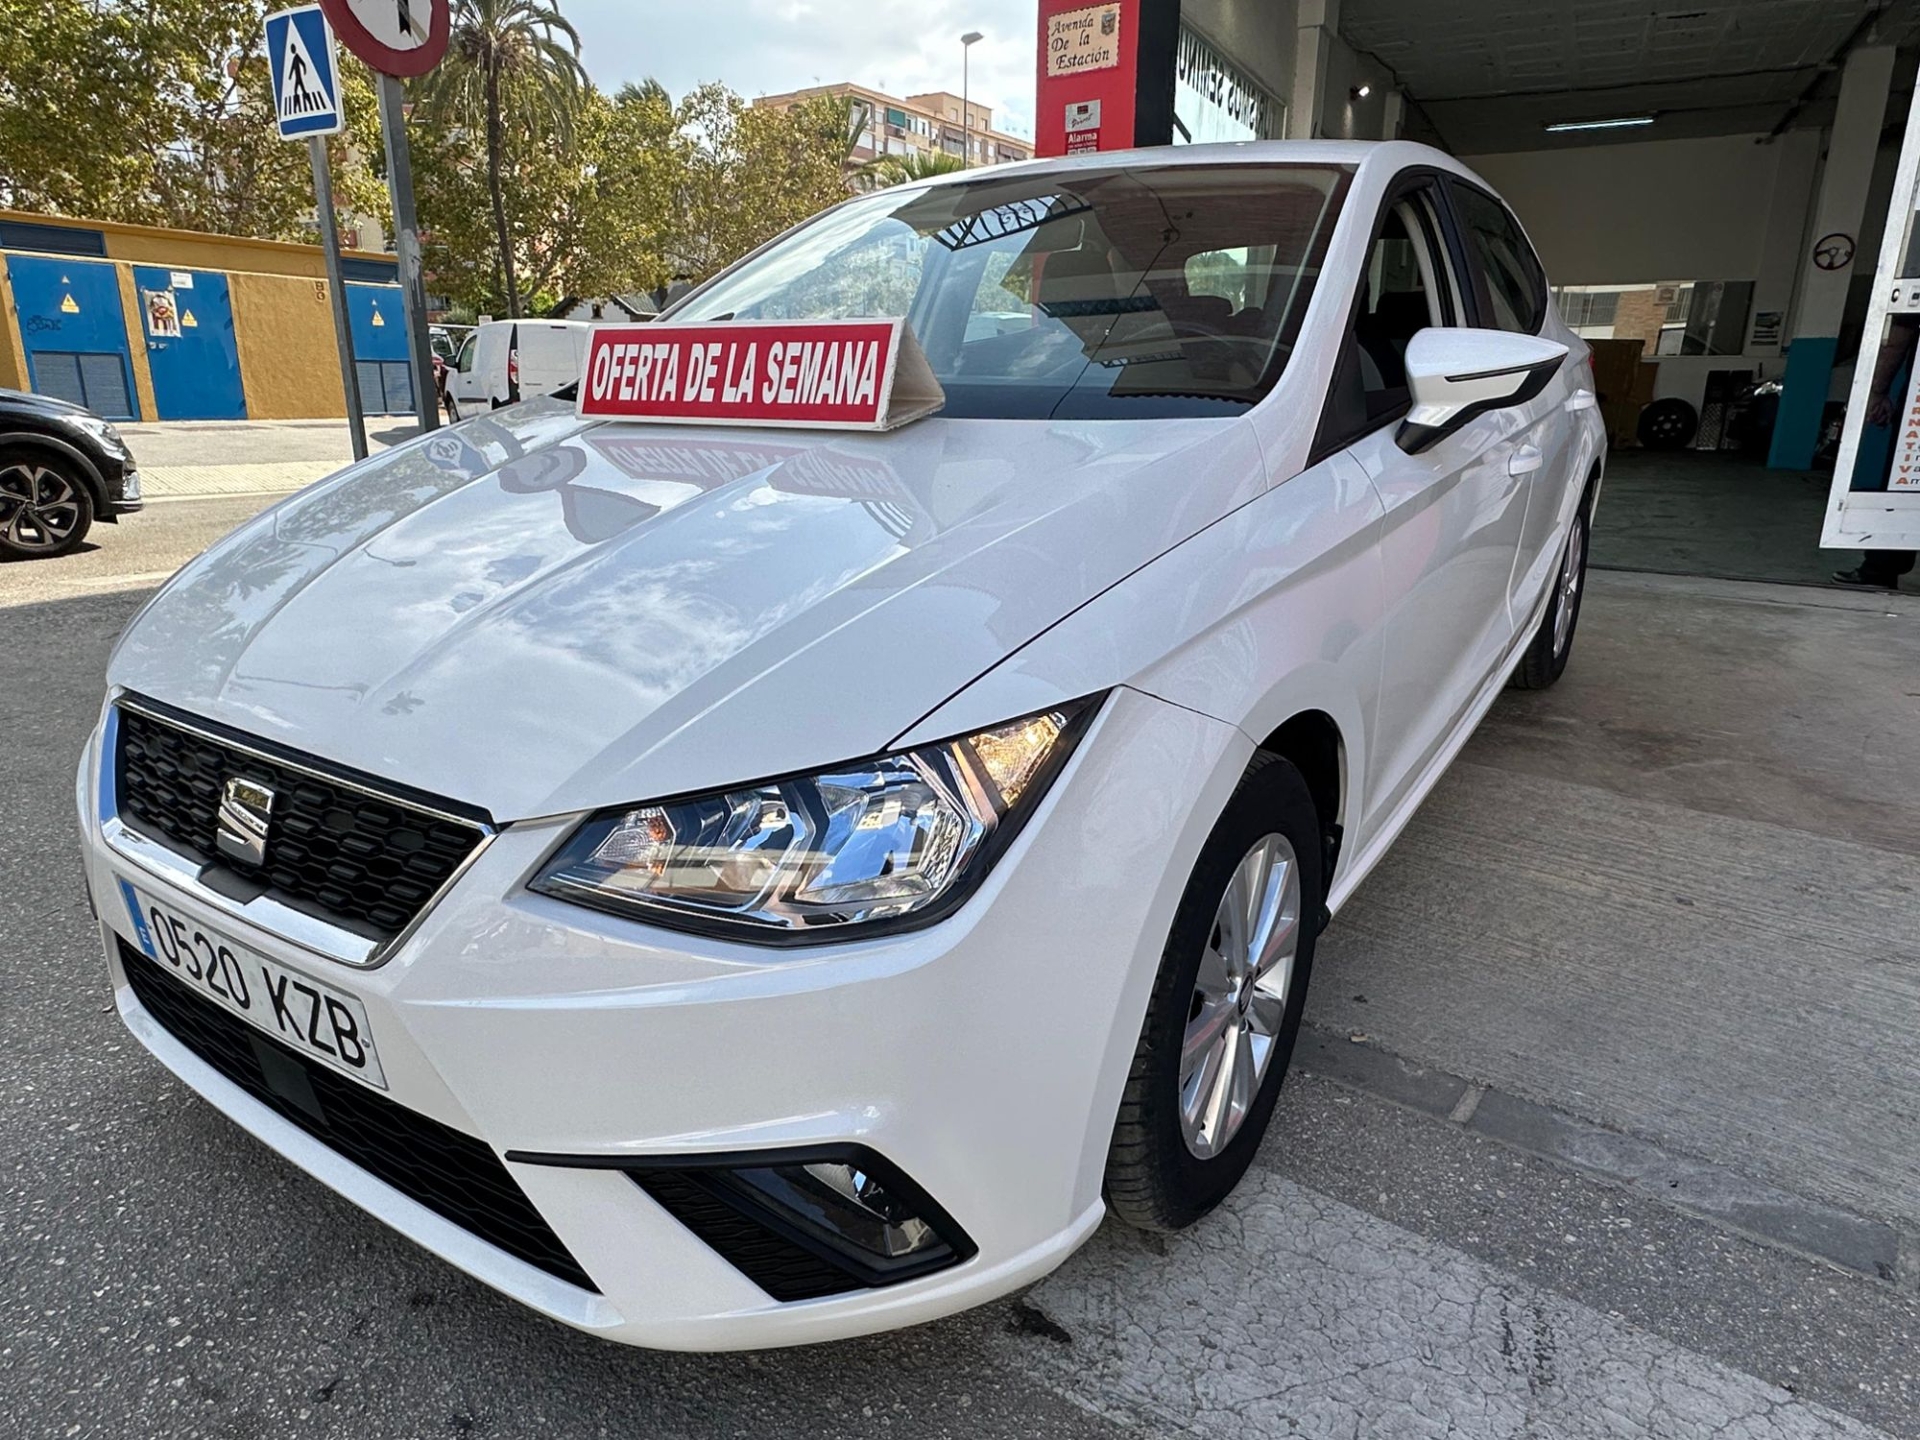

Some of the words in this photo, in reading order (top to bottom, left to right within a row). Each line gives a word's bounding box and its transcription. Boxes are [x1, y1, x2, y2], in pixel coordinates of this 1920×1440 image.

[1051, 13, 1094, 36] Avenida
[1051, 37, 1070, 52] De
[1079, 29, 1090, 47] la
[1056, 46, 1109, 70] Estación
[1068, 133, 1097, 143] Alarma
[592, 343, 680, 402] OFERTA
[683, 343, 722, 403] DE
[721, 342, 757, 403] LA
[762, 341, 879, 406] SEMANA
[151, 906, 251, 1010] 0520
[262, 966, 366, 1069] KZB
